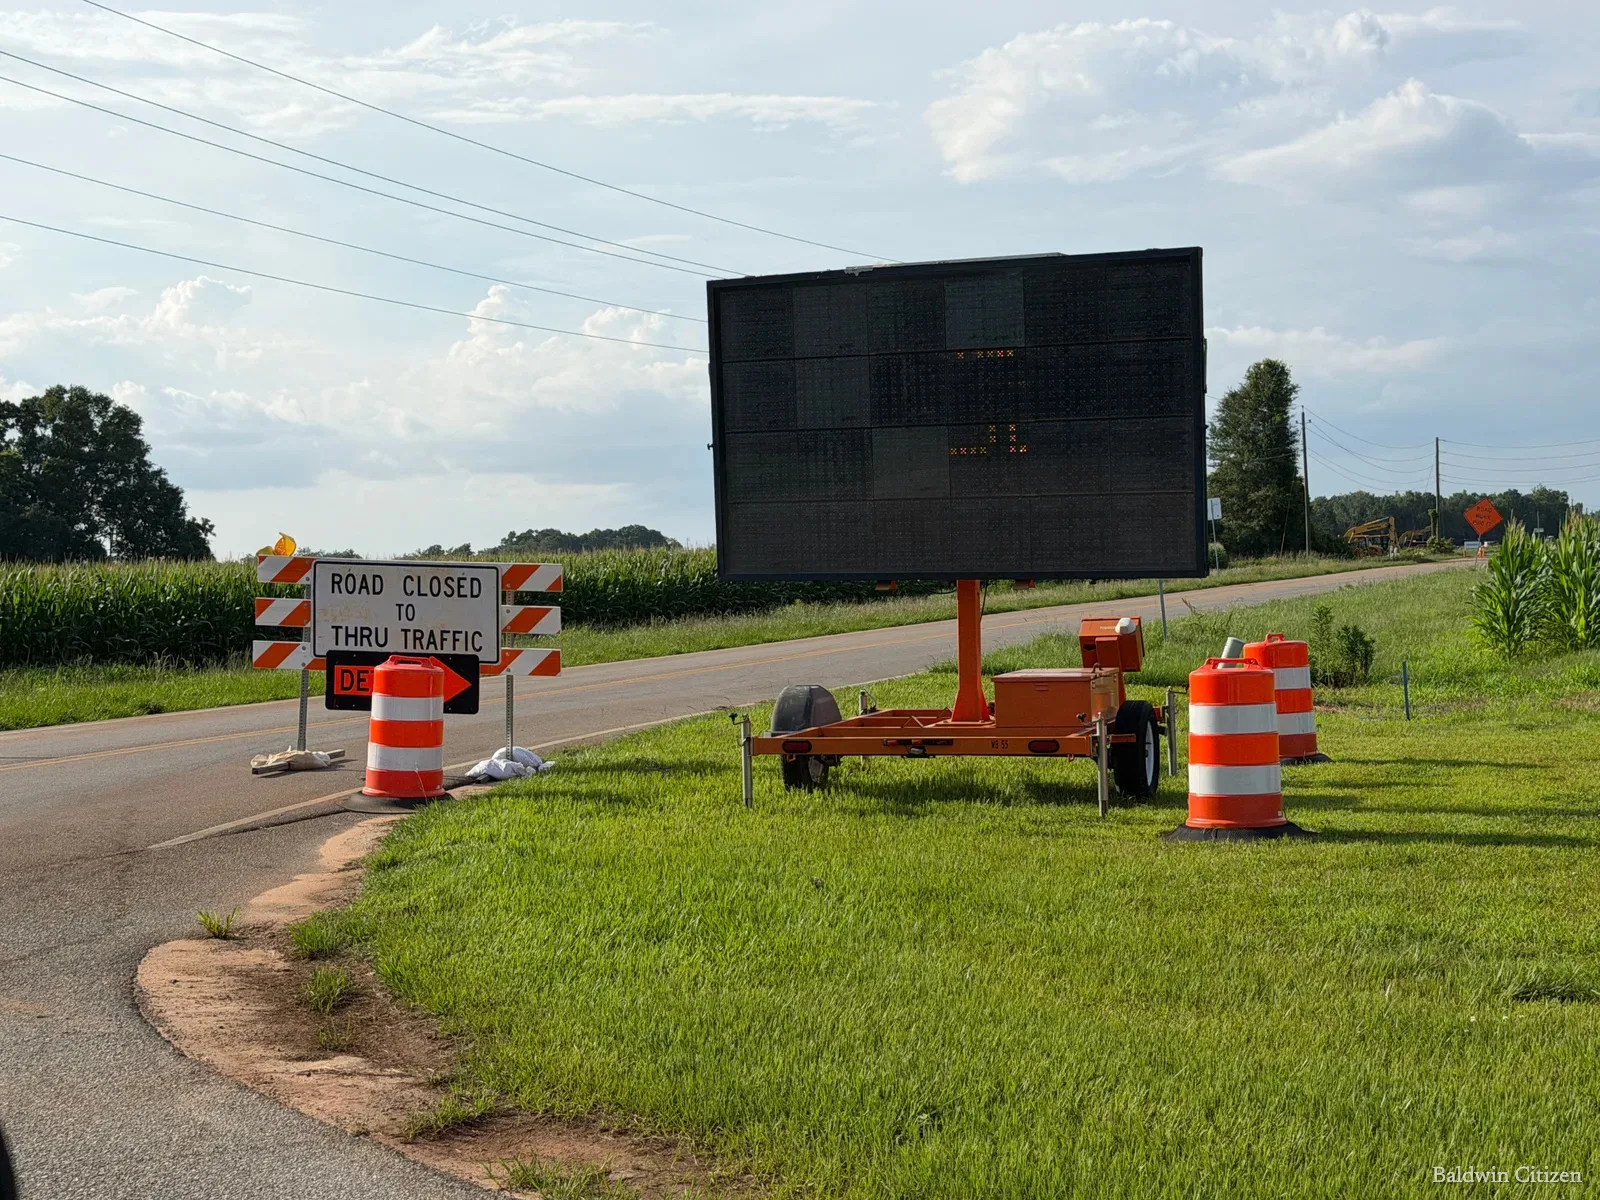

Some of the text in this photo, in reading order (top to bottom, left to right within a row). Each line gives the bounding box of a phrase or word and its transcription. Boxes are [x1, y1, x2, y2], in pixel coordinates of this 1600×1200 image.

[331, 573, 482, 598] ROAD CLOSED
[396, 603, 416, 621] TO
[331, 625, 483, 652] THRU TRAFFIC
